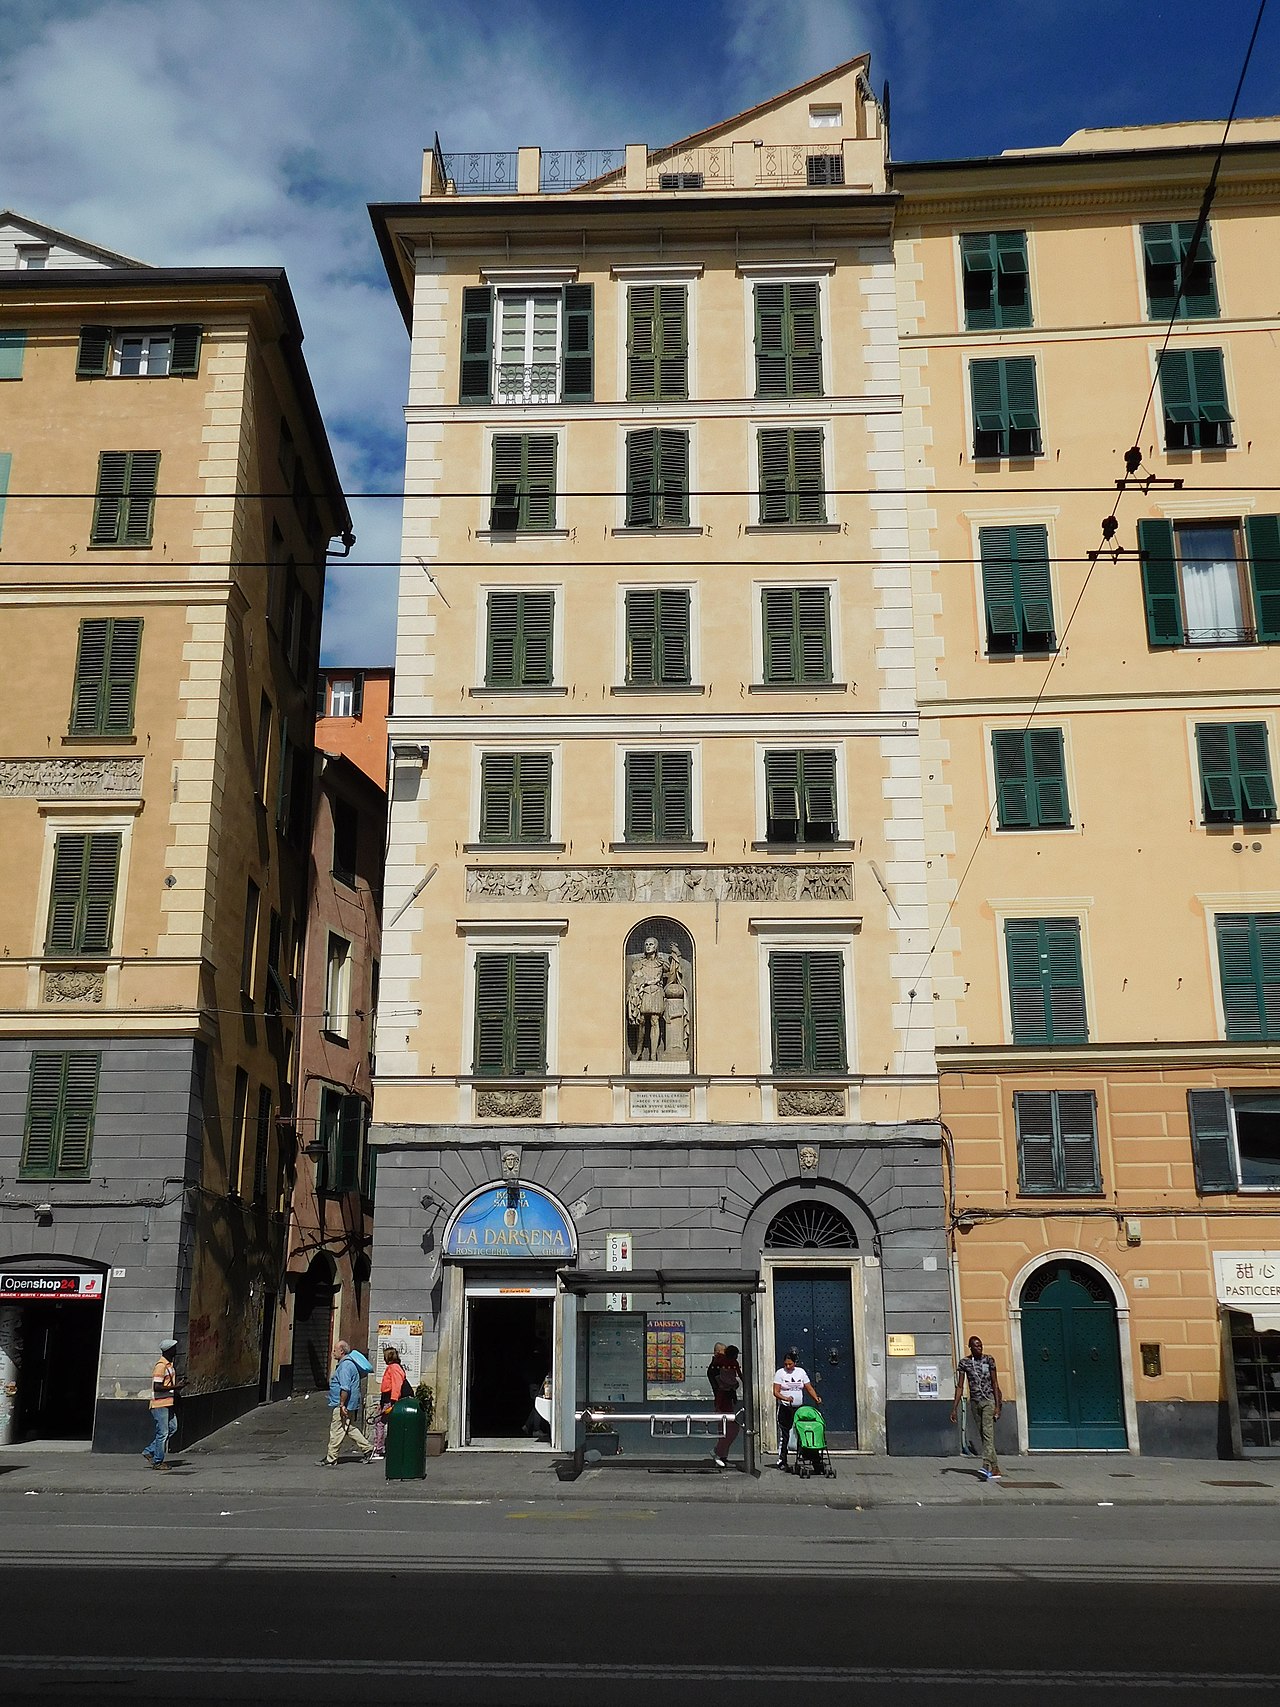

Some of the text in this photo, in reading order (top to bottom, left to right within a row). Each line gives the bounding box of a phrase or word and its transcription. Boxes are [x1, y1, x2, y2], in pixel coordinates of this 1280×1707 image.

[457, 1228, 564, 1246] LA DARSENA
[456, 1247, 510, 1256] ROSTICCERIA
[5, 1278, 75, 1290] Openshop24
